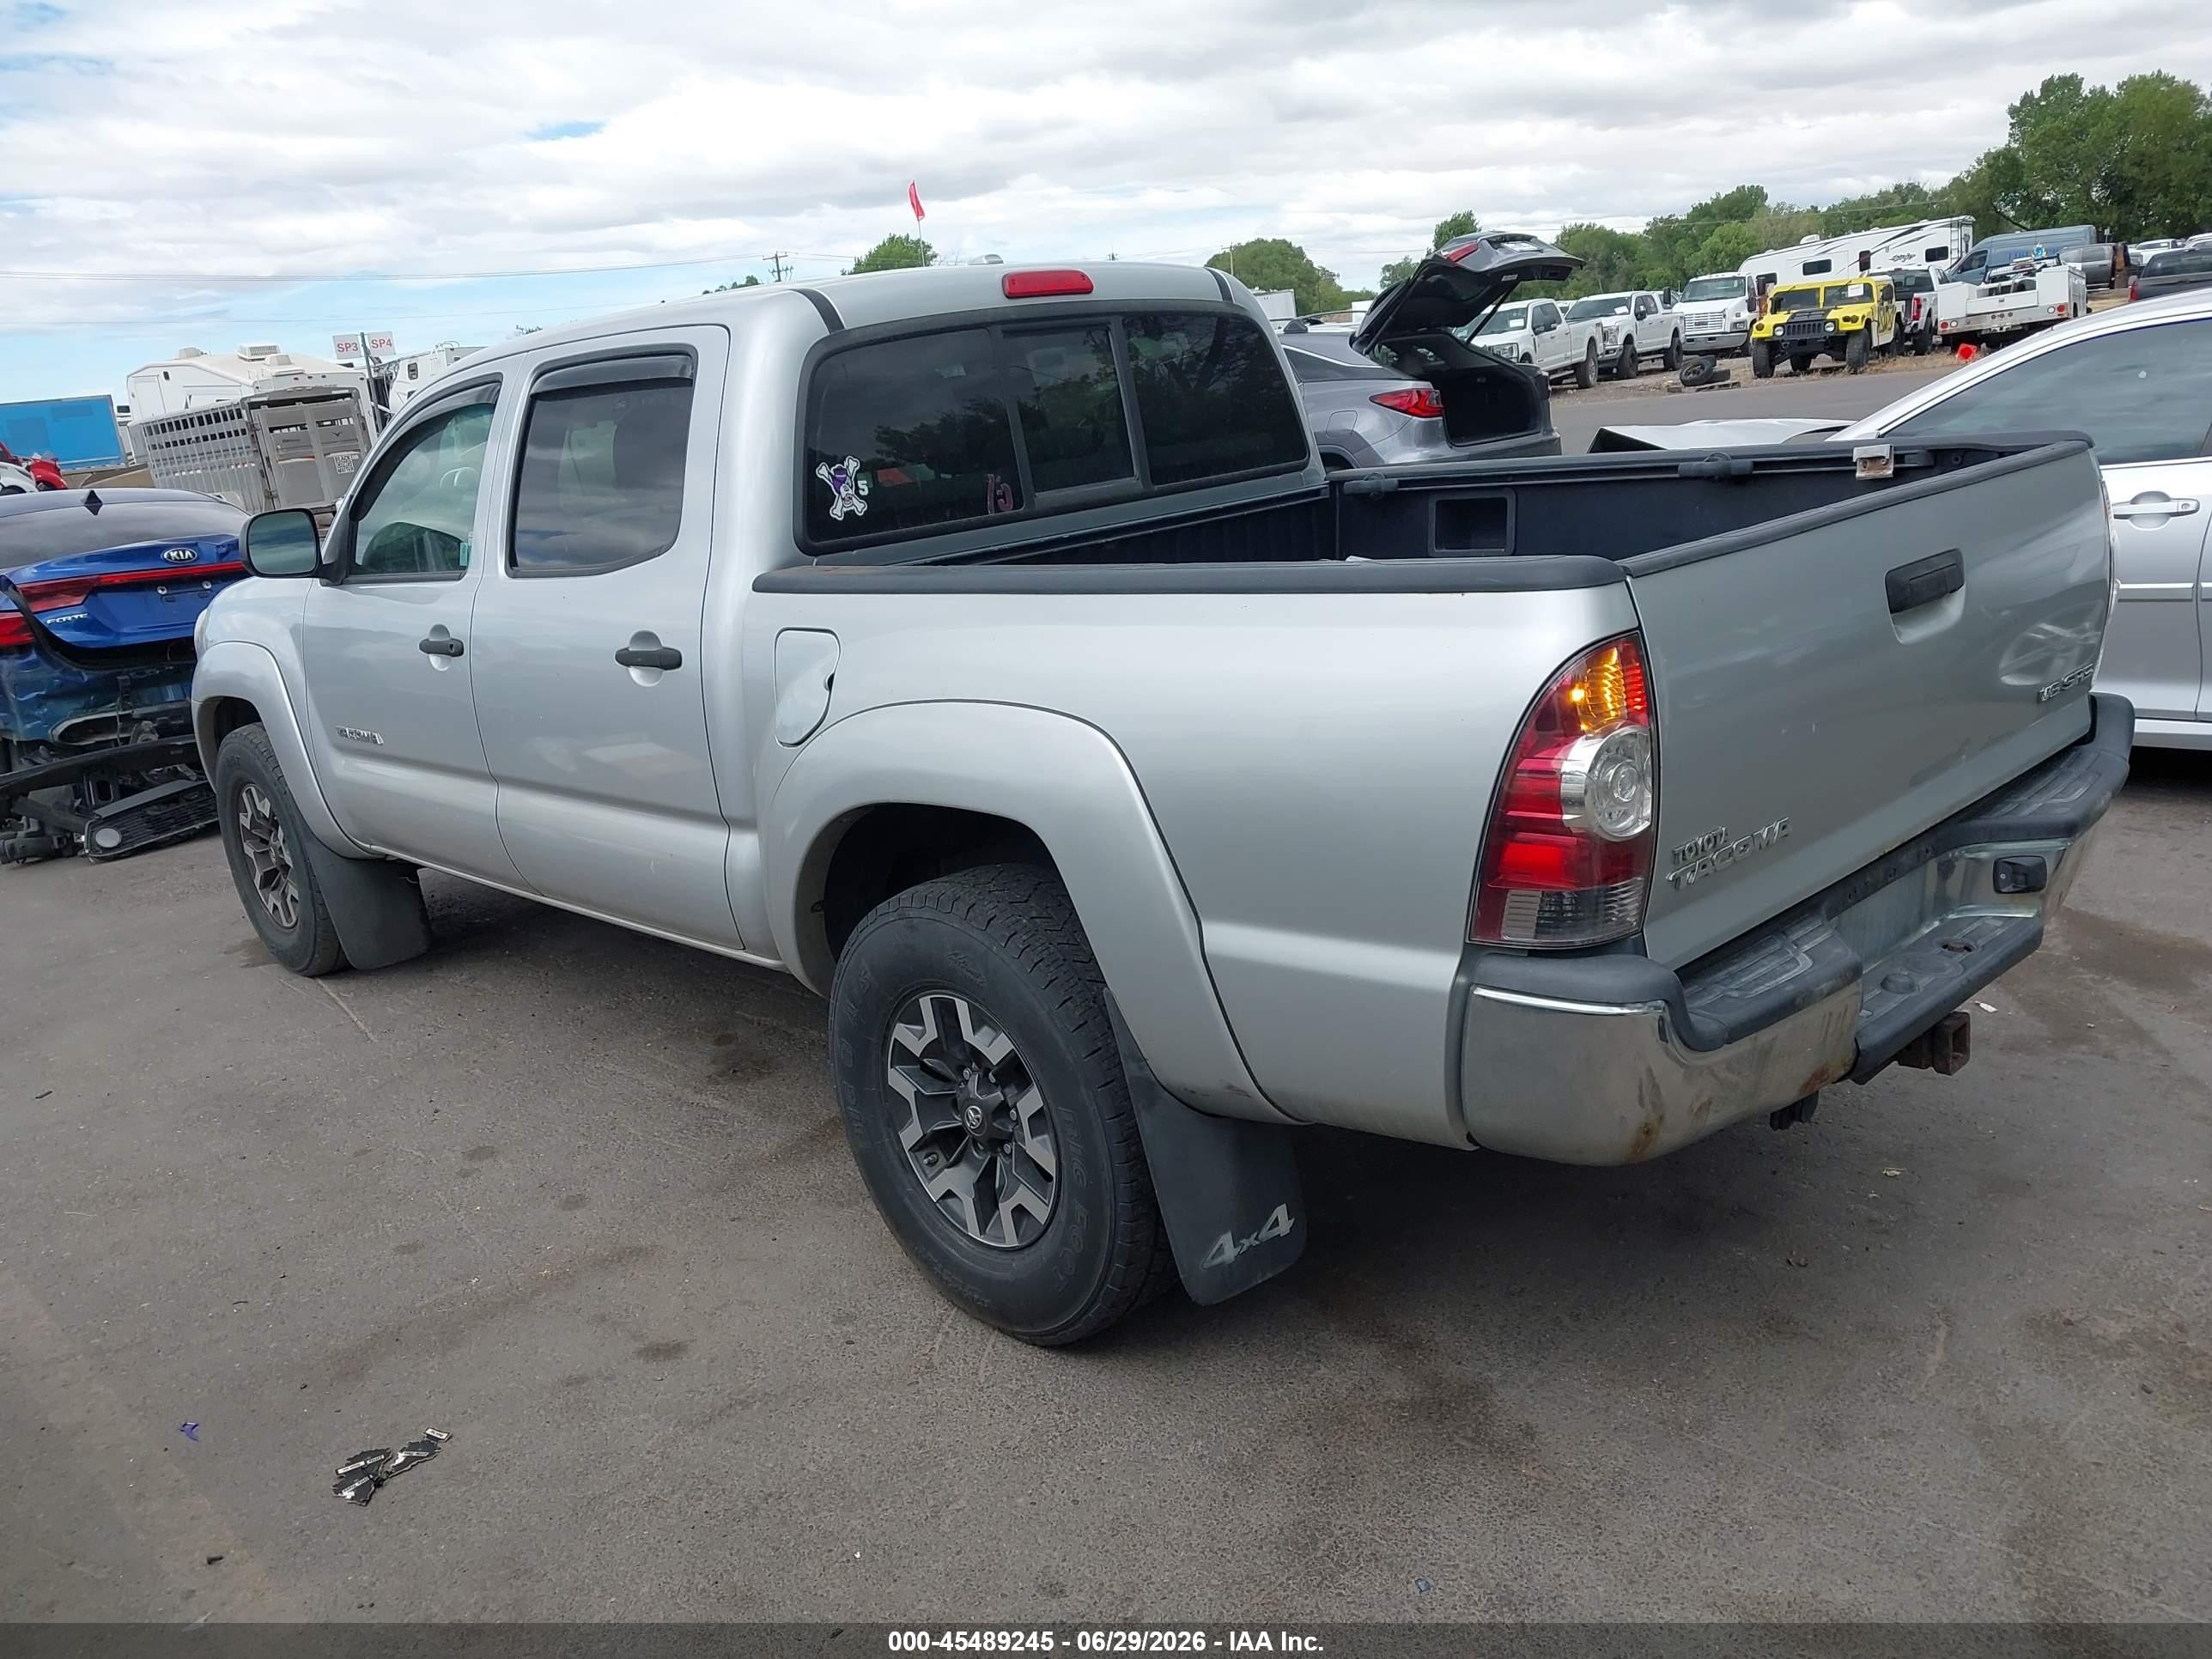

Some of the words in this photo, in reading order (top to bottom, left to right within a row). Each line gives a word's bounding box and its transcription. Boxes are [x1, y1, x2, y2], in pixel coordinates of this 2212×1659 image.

[337, 342, 359, 353] SP3
[371, 338, 392, 349] SP4
[857, 480, 869, 496] 5
[169, 550, 193, 561] KIA
[1665, 817, 1790, 888] TACOMA
[1200, 1202, 1295, 1269] 4x4
